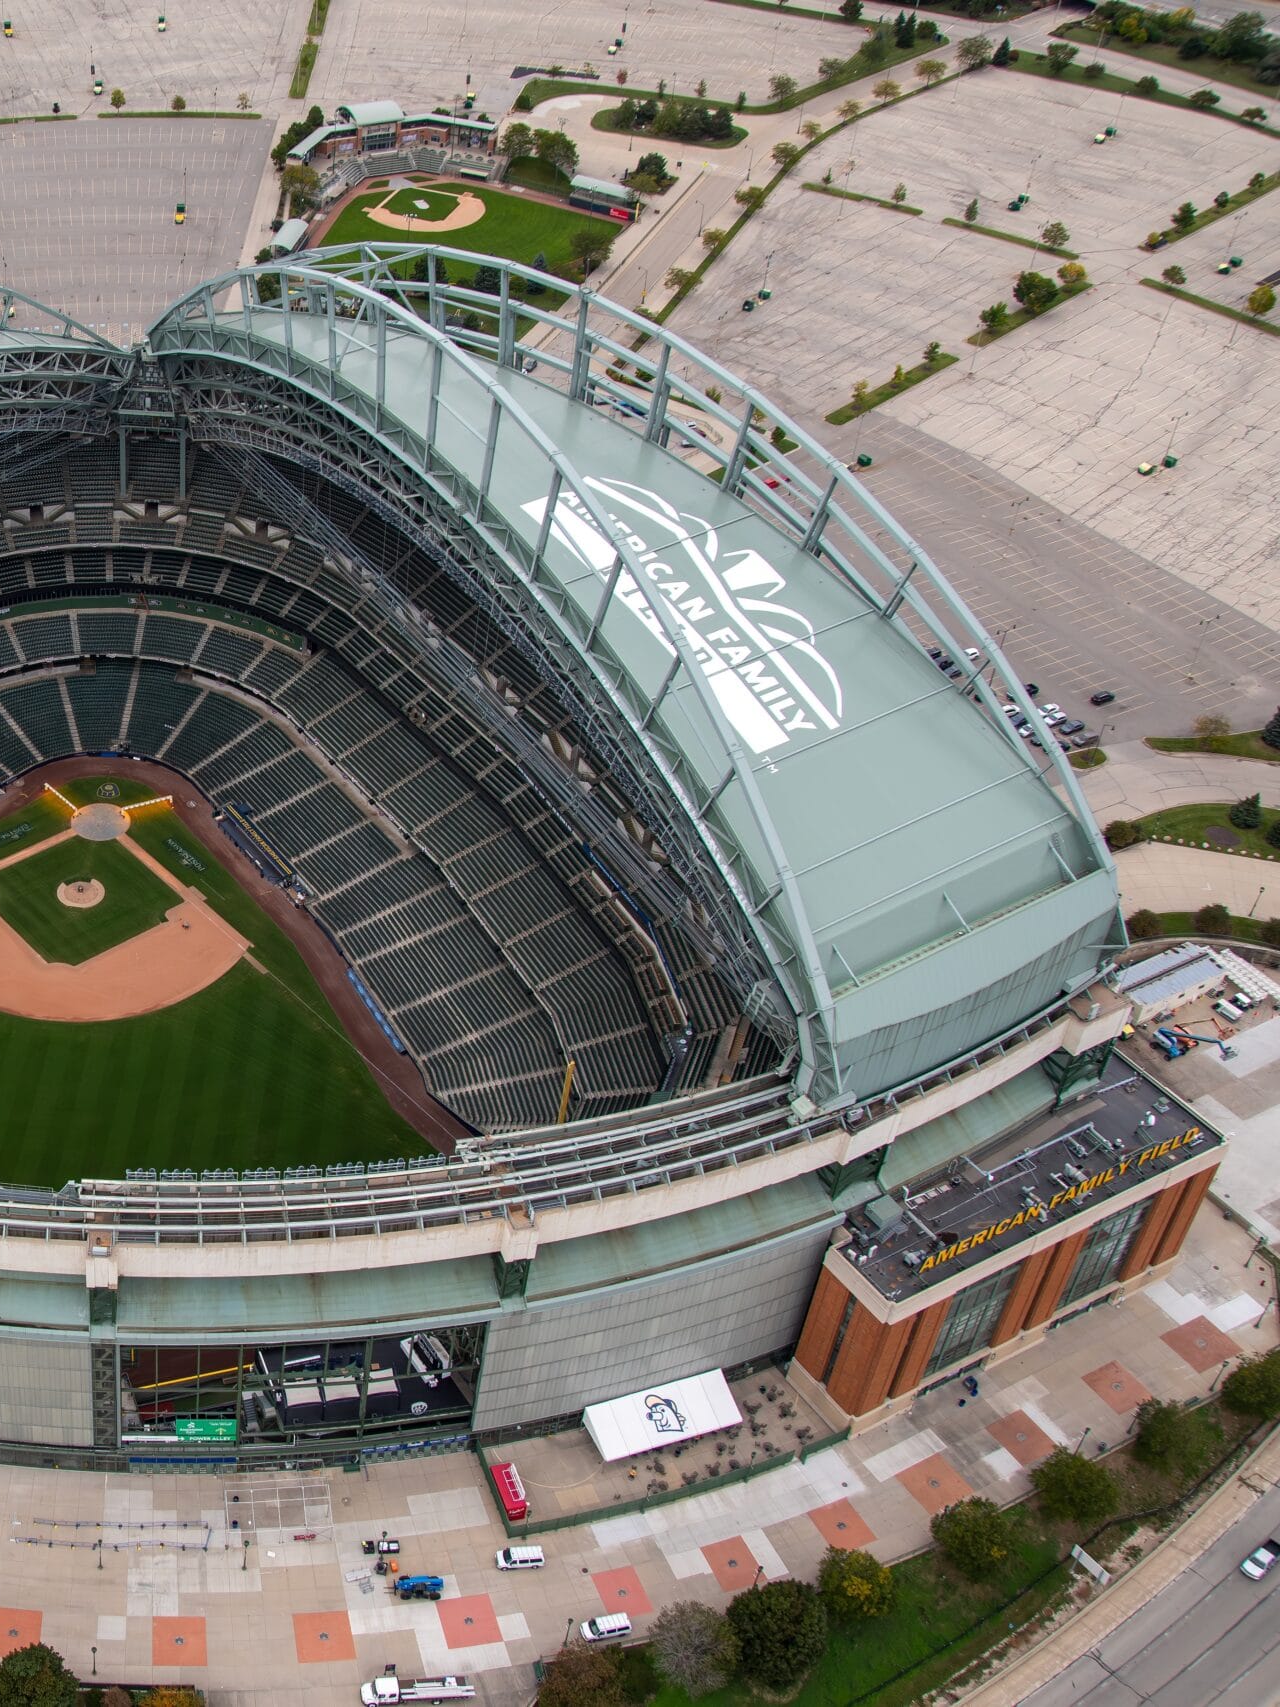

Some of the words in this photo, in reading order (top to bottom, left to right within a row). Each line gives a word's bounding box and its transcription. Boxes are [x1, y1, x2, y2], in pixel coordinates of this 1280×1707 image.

[705, 626, 818, 732] FAMILY
[918, 1201, 1043, 1275] AMERICAN
[1048, 1158, 1132, 1211] FAMILY
[1136, 1126, 1201, 1167] FIELD
